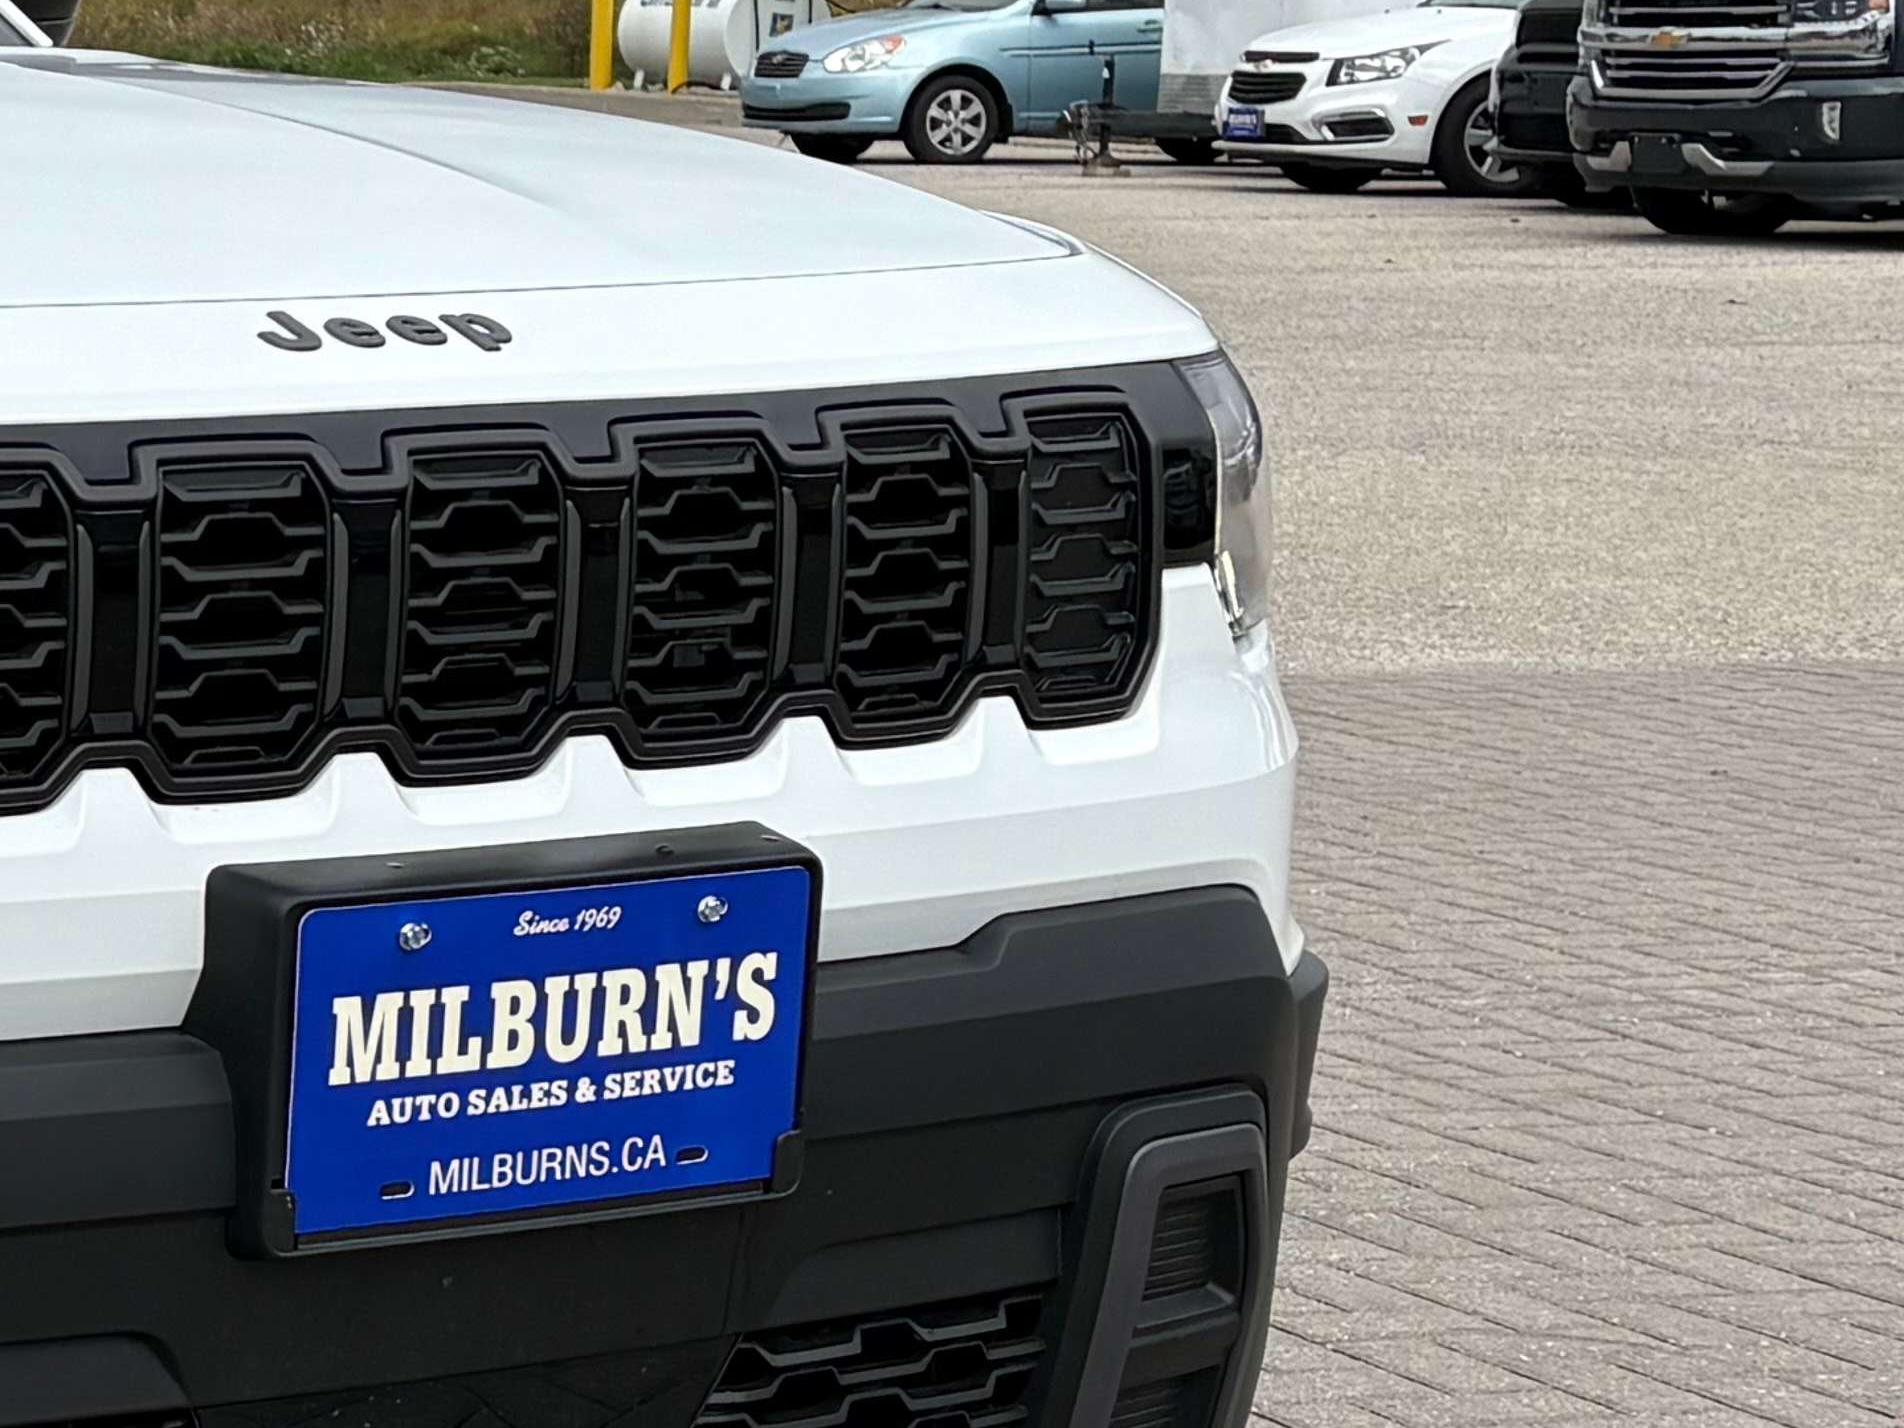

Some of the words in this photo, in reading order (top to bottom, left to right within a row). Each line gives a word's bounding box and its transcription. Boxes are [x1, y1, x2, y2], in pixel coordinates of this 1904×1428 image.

[257, 310, 513, 352] Jeep
[513, 910, 570, 936] Since
[573, 906, 622, 932] 1969
[328, 951, 778, 1086] MILBURN'S
[366, 1091, 460, 1127] AUTO
[466, 1079, 569, 1116] SALES
[574, 1076, 597, 1104] &
[603, 1059, 736, 1100] SERVICE
[428, 1134, 666, 1196] MILBURNS.CA
